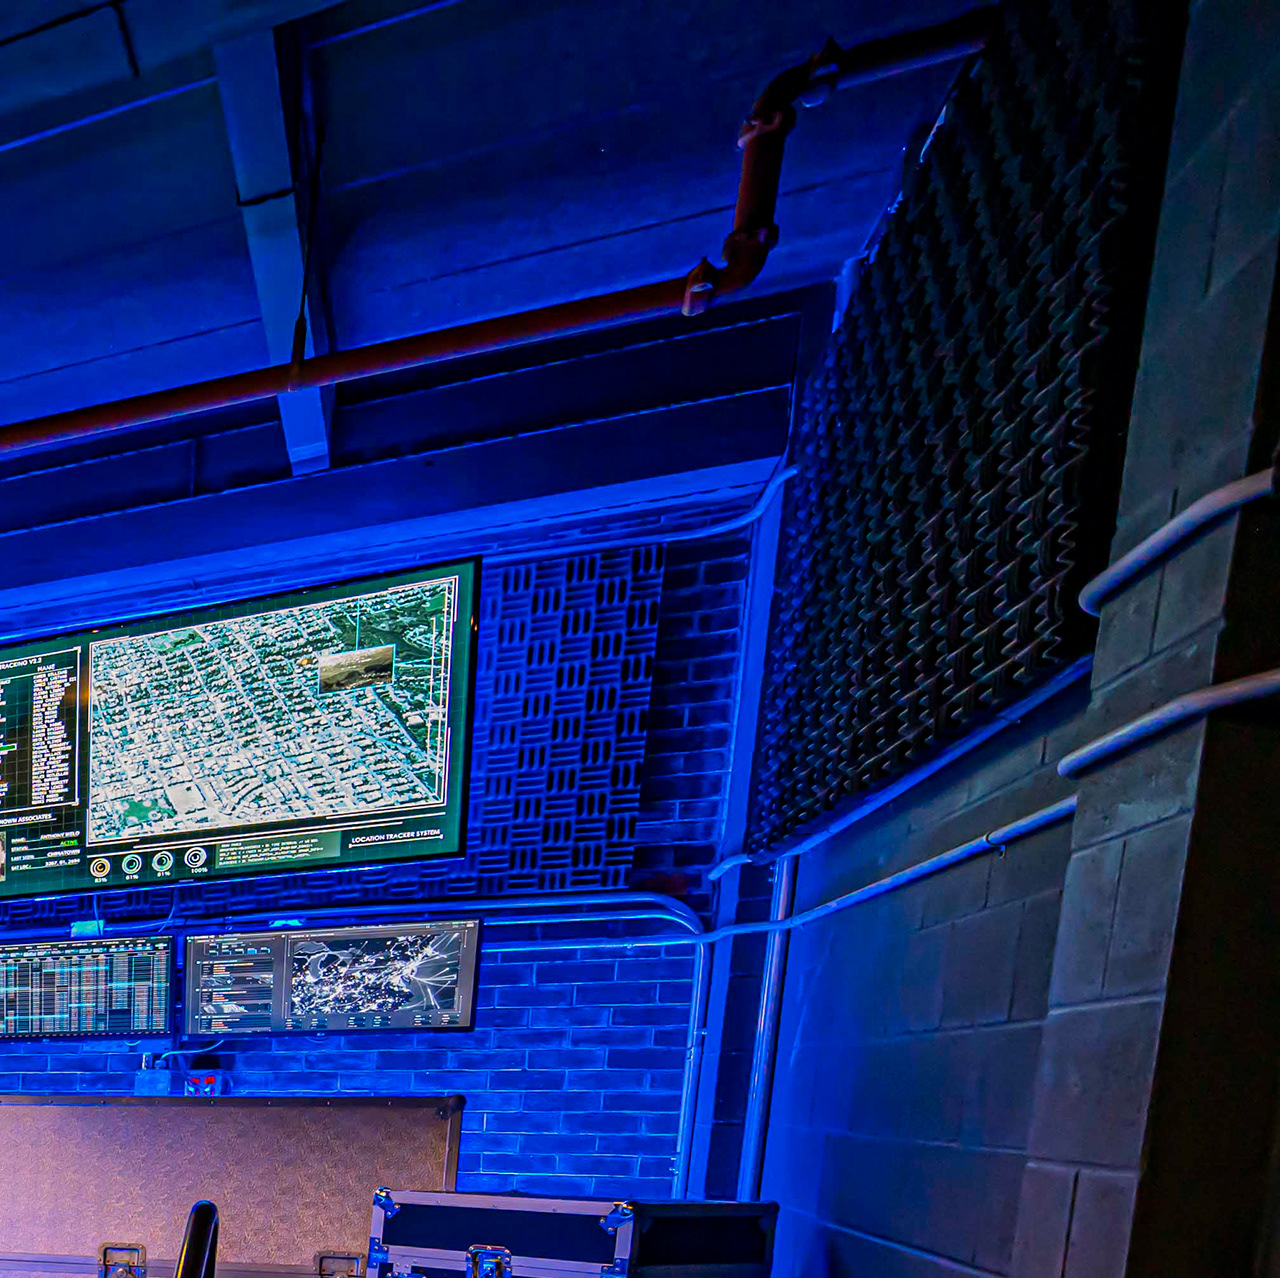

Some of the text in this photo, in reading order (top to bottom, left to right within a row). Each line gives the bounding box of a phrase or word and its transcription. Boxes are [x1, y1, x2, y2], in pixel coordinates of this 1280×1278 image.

[352, 829, 440, 843] LOCATION TRACKER SYSTEM
